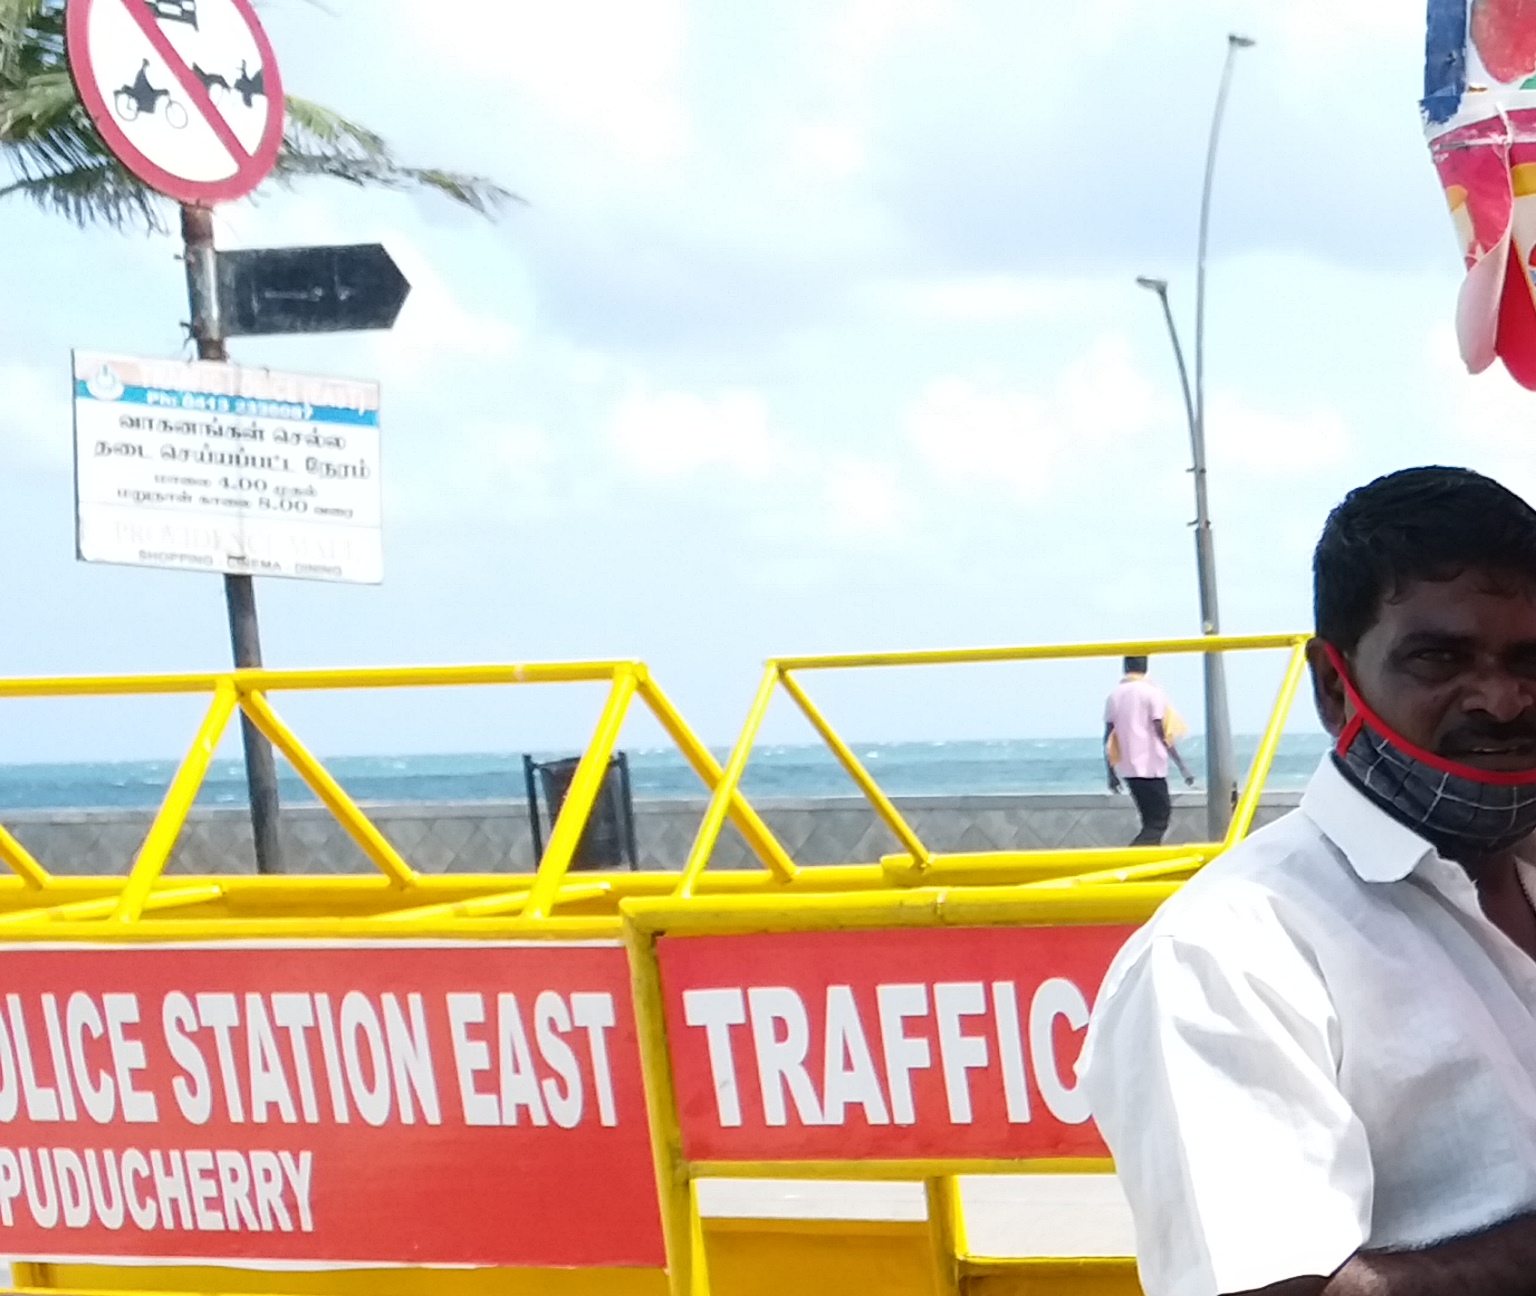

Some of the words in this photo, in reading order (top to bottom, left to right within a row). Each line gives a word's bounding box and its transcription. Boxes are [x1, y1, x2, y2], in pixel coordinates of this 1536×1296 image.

[162, 990, 440, 1126] STATION
[446, 990, 618, 1129] EAST
[683, 977, 1093, 1127] TRAFFIC
[0, 1148, 315, 1233] PUDUCHERRY
